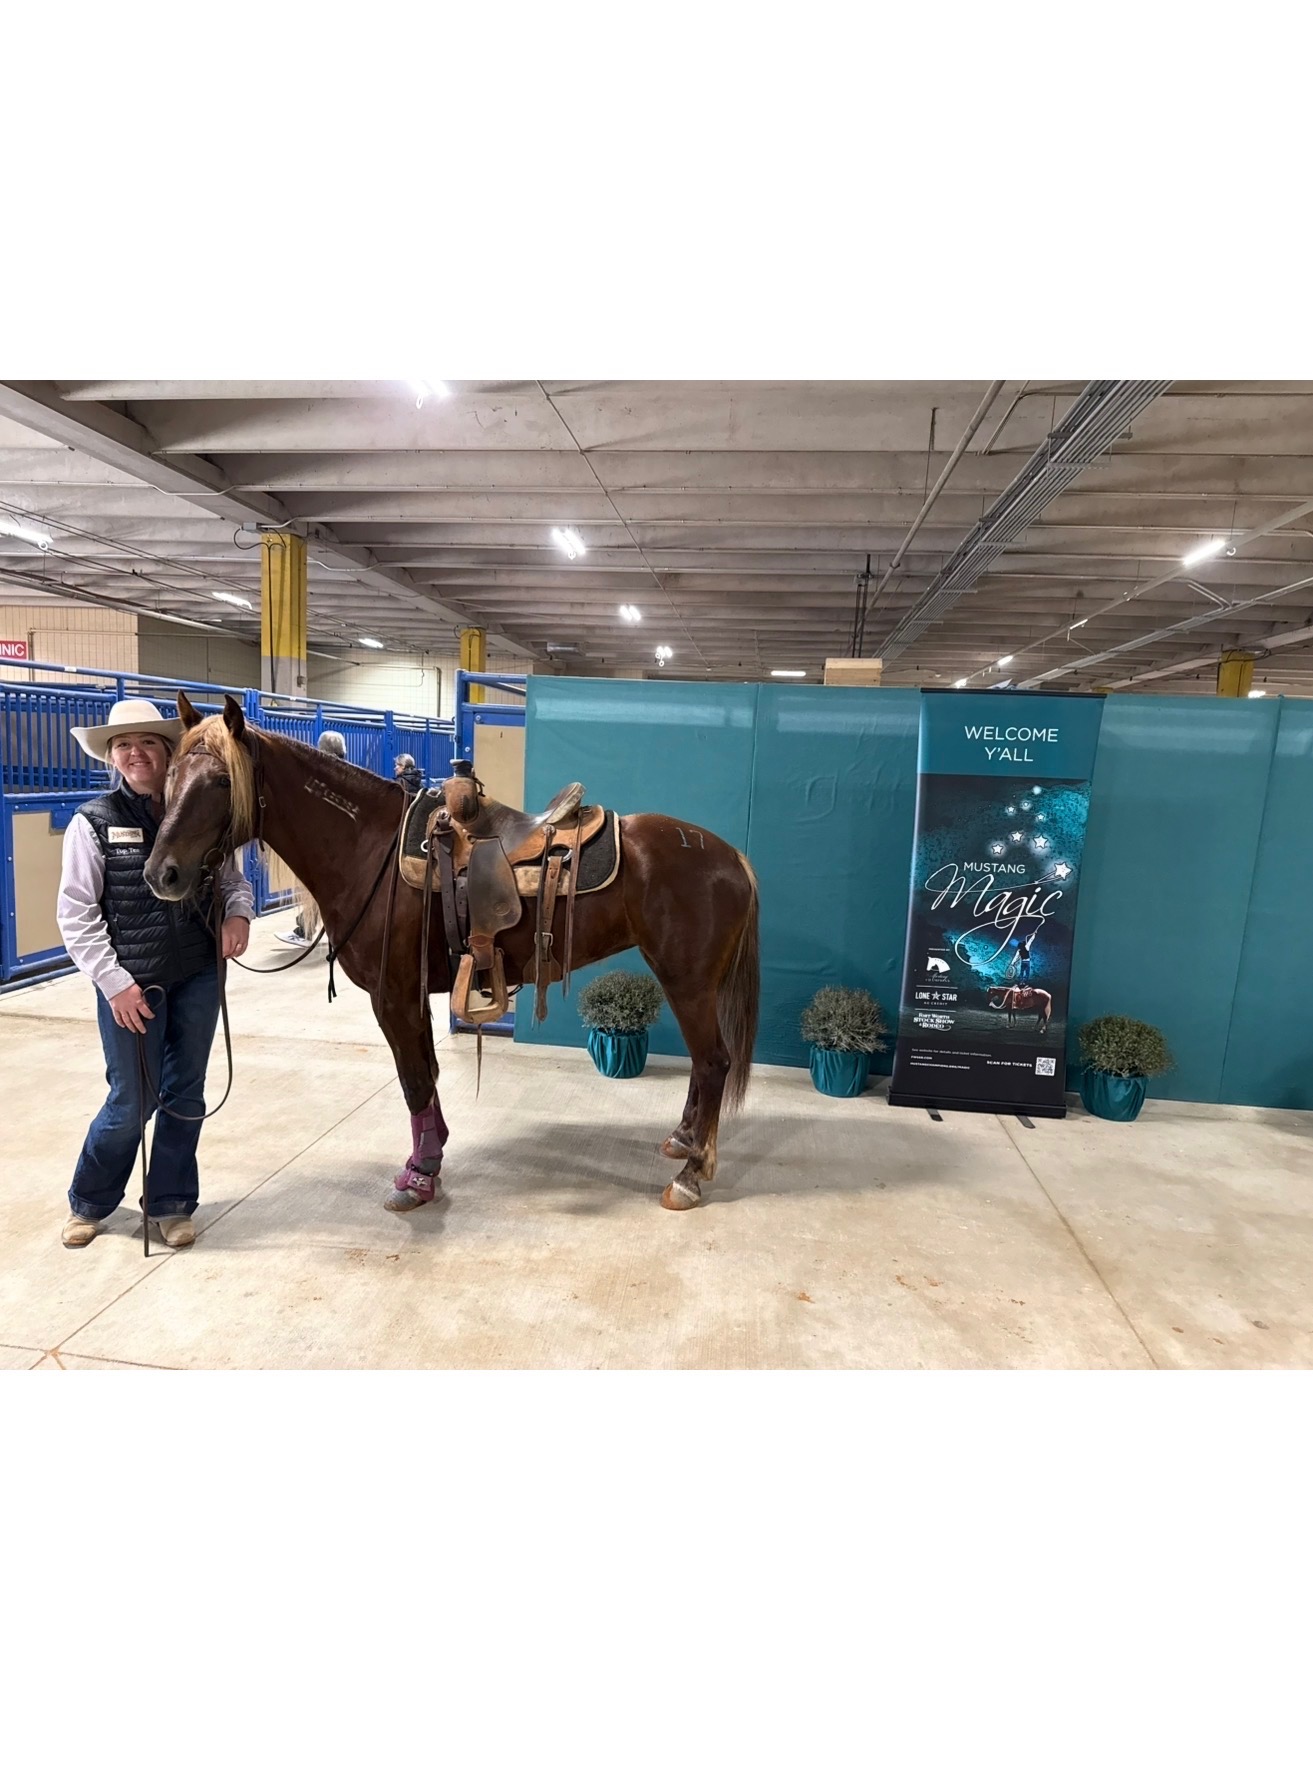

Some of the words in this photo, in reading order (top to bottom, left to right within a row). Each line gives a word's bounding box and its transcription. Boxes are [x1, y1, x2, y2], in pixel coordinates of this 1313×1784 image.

[964, 725, 1059, 742] WELCOME
[984, 746, 1034, 762] Y'ALL
[963, 861, 1026, 874] MUSTANG
[925, 863, 1063, 966] Magic
[915, 992, 930, 1000] LONE
[941, 993, 958, 1001] STAR
